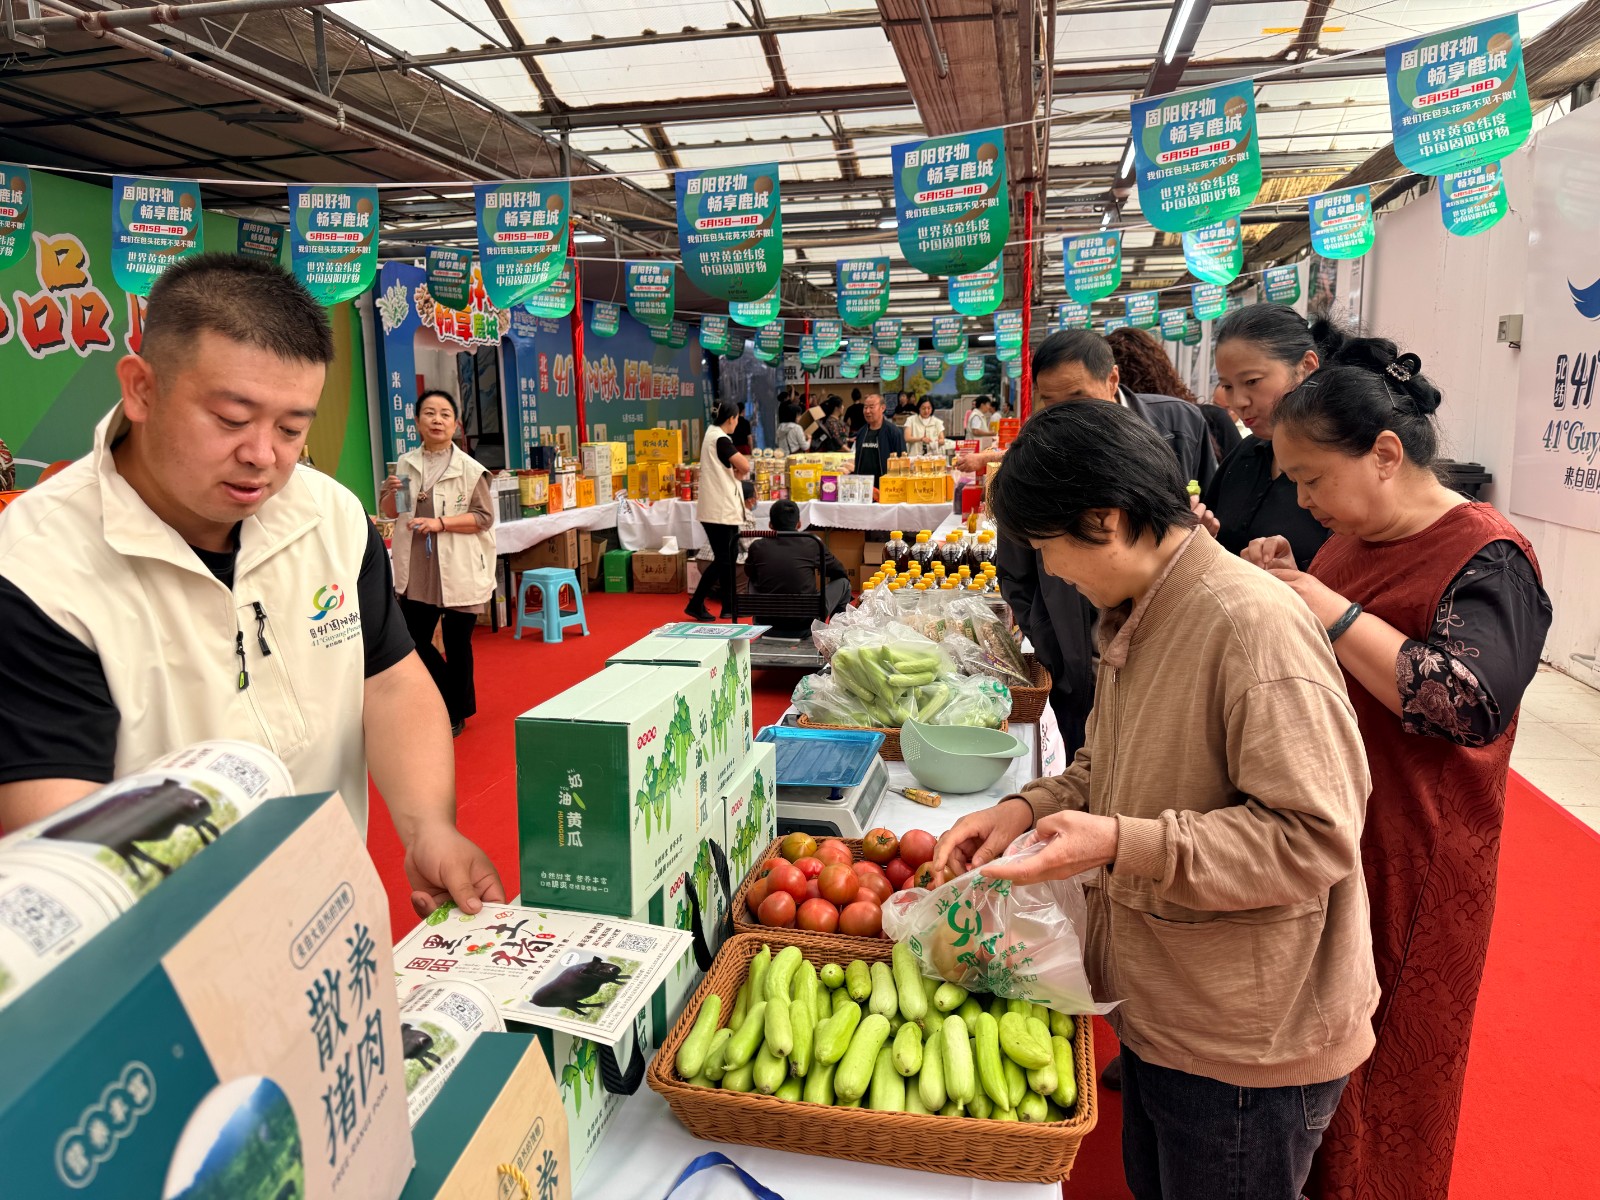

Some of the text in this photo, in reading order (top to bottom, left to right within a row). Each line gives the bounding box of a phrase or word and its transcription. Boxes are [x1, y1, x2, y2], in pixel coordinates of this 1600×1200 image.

[1401, 35, 1478, 71] 固阳好物
[1427, 50, 1507, 87] 畅享鹿城
[1145, 97, 1216, 129] 固阳好物
[1402, 90, 1517, 126] 我们在包头花苑不见不散!
[1170, 114, 1242, 144] 畅享鹿城
[1418, 113, 1507, 146] 世界黄金纬度
[1420, 125, 1510, 158] 中国固阳好物
[905, 143, 970, 168] 固阳好物
[927, 159, 993, 185] 畅享鹿城
[1147, 152, 1249, 181] 我们在包头花苑不见不散!
[123, 186, 174, 203] 固阳好物
[687, 174, 748, 194] 固阳好物
[1160, 173, 1240, 200] 世界黄金纬度
[299, 194, 350, 208] 固阳好物
[485, 191, 540, 208] 固阳好物
[707, 191, 769, 212] 畅享鹿城
[906, 198, 999, 219] 我们在包头花苑不见不散!
[1161, 185, 1240, 213] 中国固阳好物
[141, 205, 192, 222] 畅享鹿城
[317, 212, 370, 227] 畅享鹿城
[505, 210, 560, 227] 畅享鹿城
[688, 229, 774, 243] 我们在包头花苑不见不散!
[918, 218, 989, 239] 世界黄金纬度
[919, 232, 991, 252] 中国固阳好物
[699, 248, 765, 264] 世界黄金纬度
[307, 262, 361, 273] 世界黄金纬度
[496, 262, 551, 275] 世界黄金纬度
[701, 261, 767, 276] 中国固阳好物
[306, 273, 360, 284] 中国固阳好物
[624, 358, 652, 400] 好物
[1555, 356, 1568, 407] 北纬
[392, 371, 405, 454] 来自固阳
[405, 957, 458, 972] 固阳
